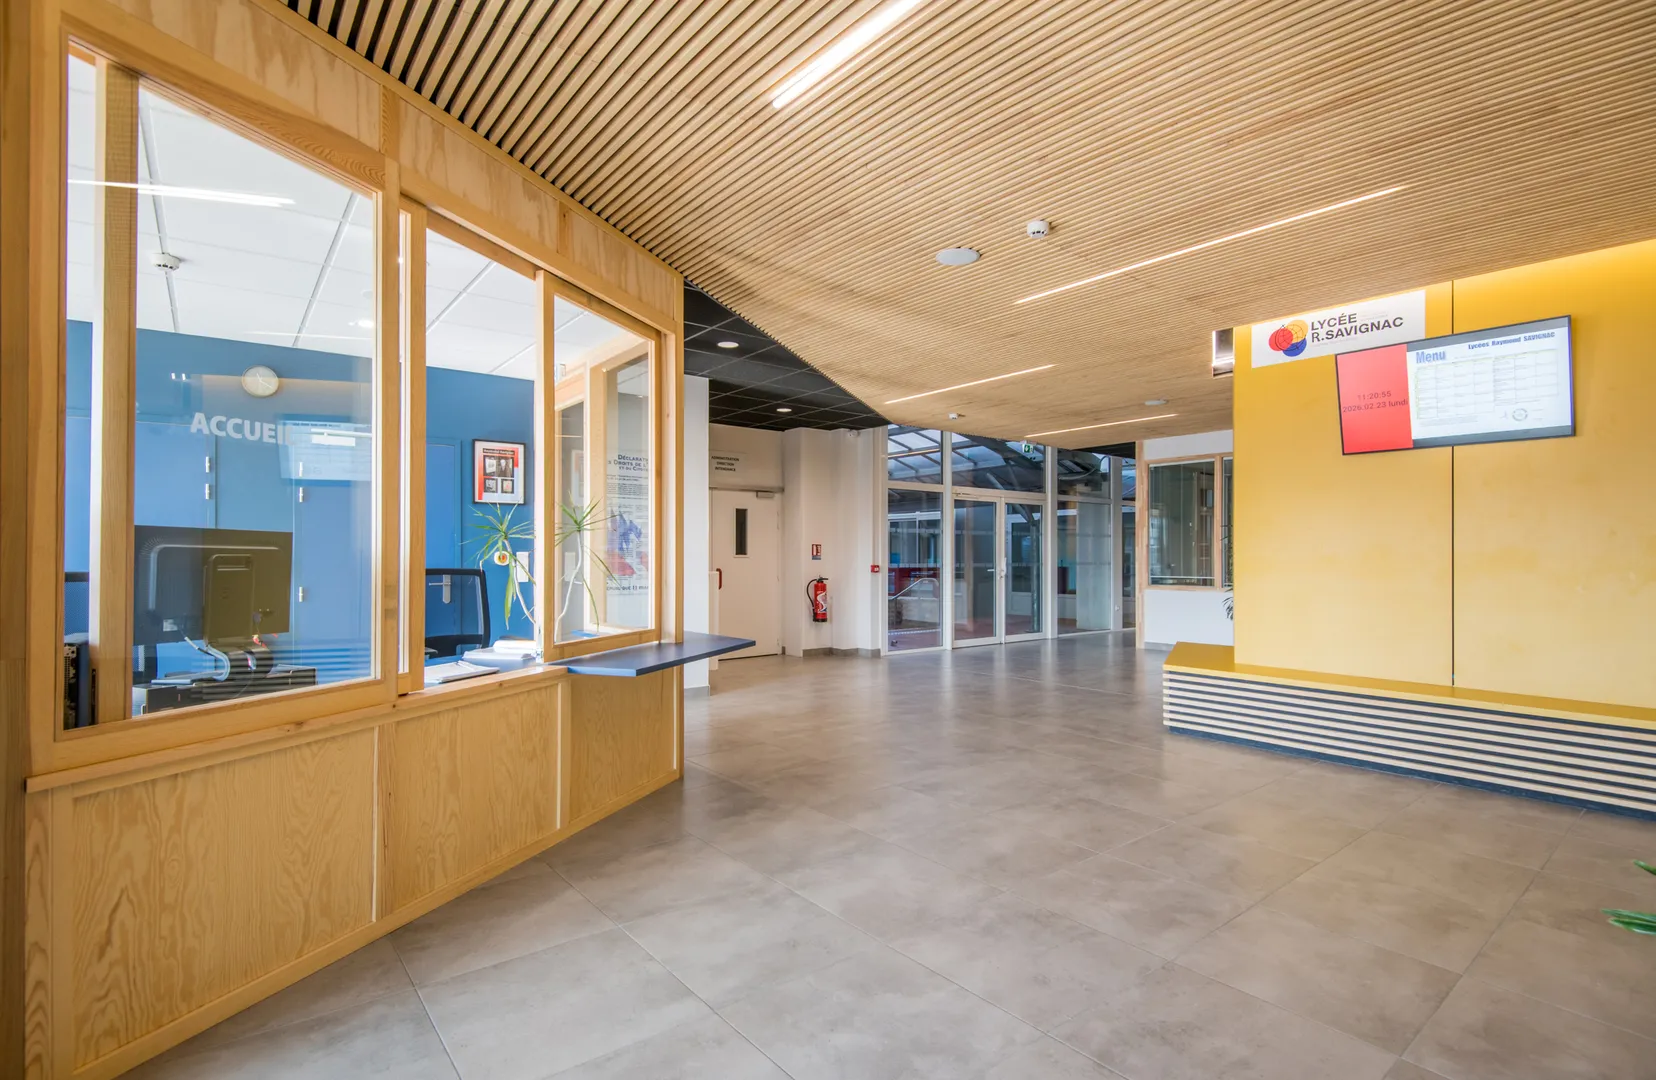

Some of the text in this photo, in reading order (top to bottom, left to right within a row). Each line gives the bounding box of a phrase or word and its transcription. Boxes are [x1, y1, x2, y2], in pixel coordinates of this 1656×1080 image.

[1311, 312, 1357, 331] LYCÉE
[1311, 317, 1404, 343] R.SAVIGNAC
[1523, 331, 1556, 342] SAVIGNAC
[1415, 350, 1446, 364] Menu
[1357, 390, 1392, 400] 11:20:55
